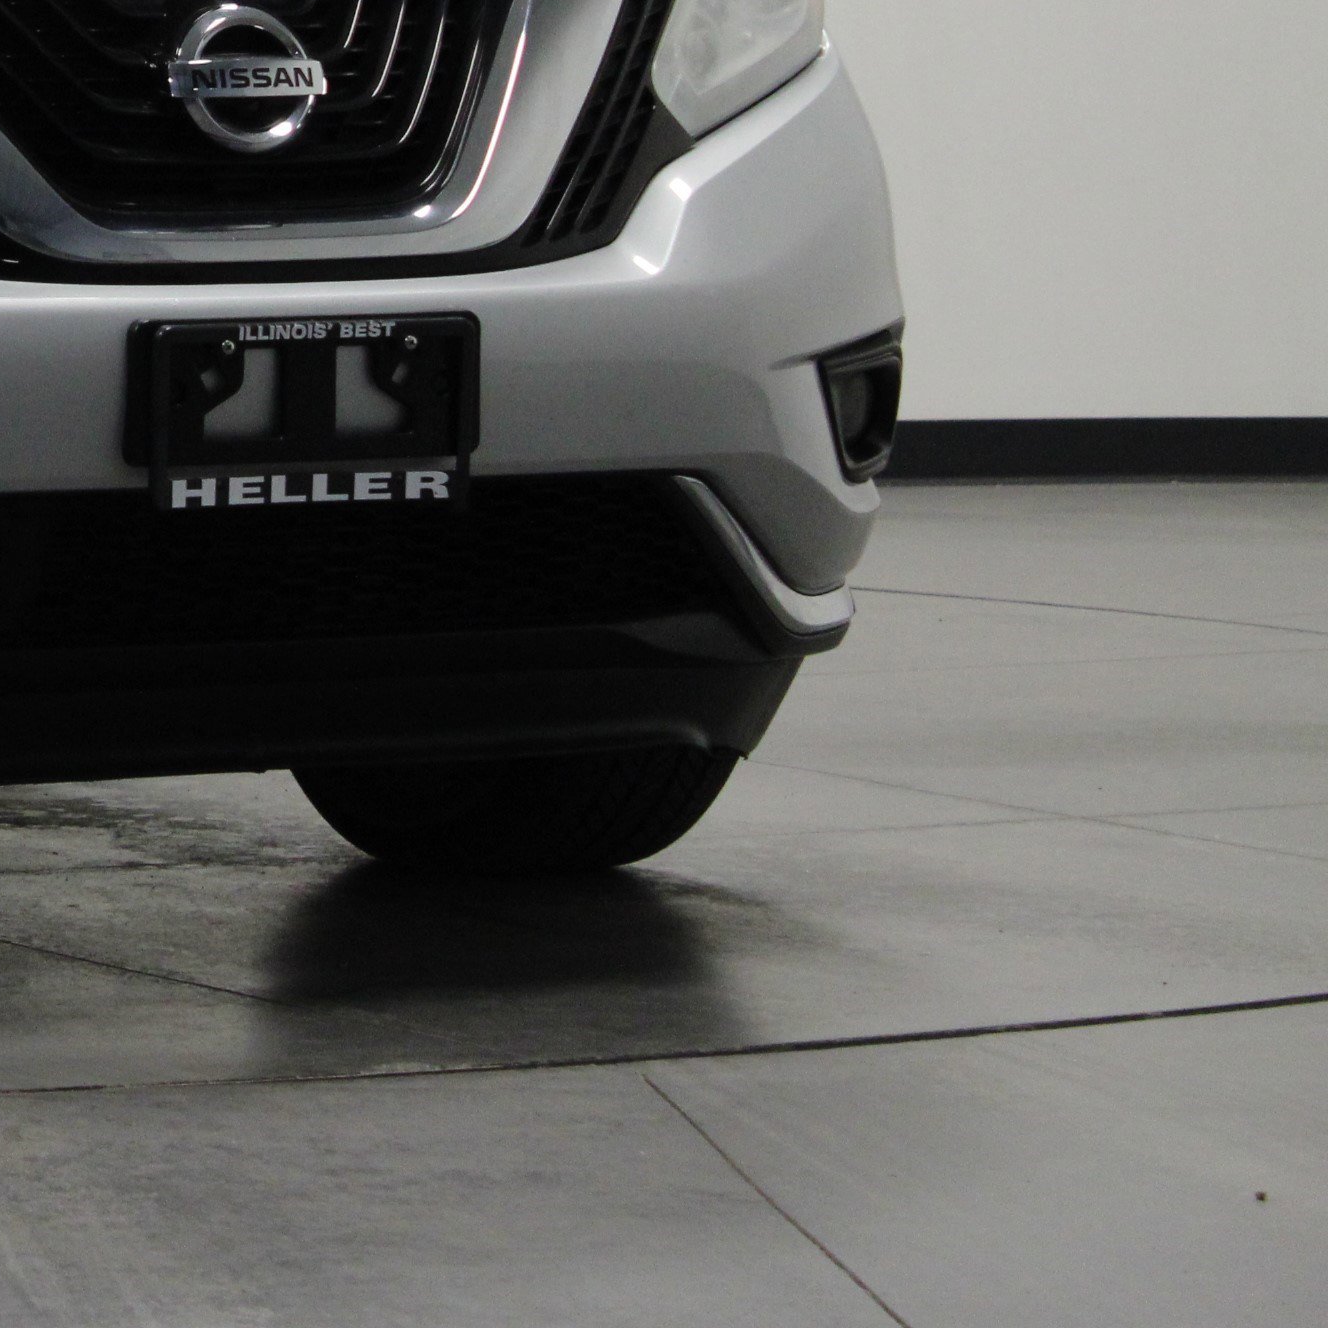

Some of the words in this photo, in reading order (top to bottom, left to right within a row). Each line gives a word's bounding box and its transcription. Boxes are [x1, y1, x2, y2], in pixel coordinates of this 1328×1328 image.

[192, 67, 314, 89] NISSAN
[239, 322, 333, 341] ILLINOIS'
[340, 321, 396, 338] BEST
[171, 471, 450, 509] HELLER
